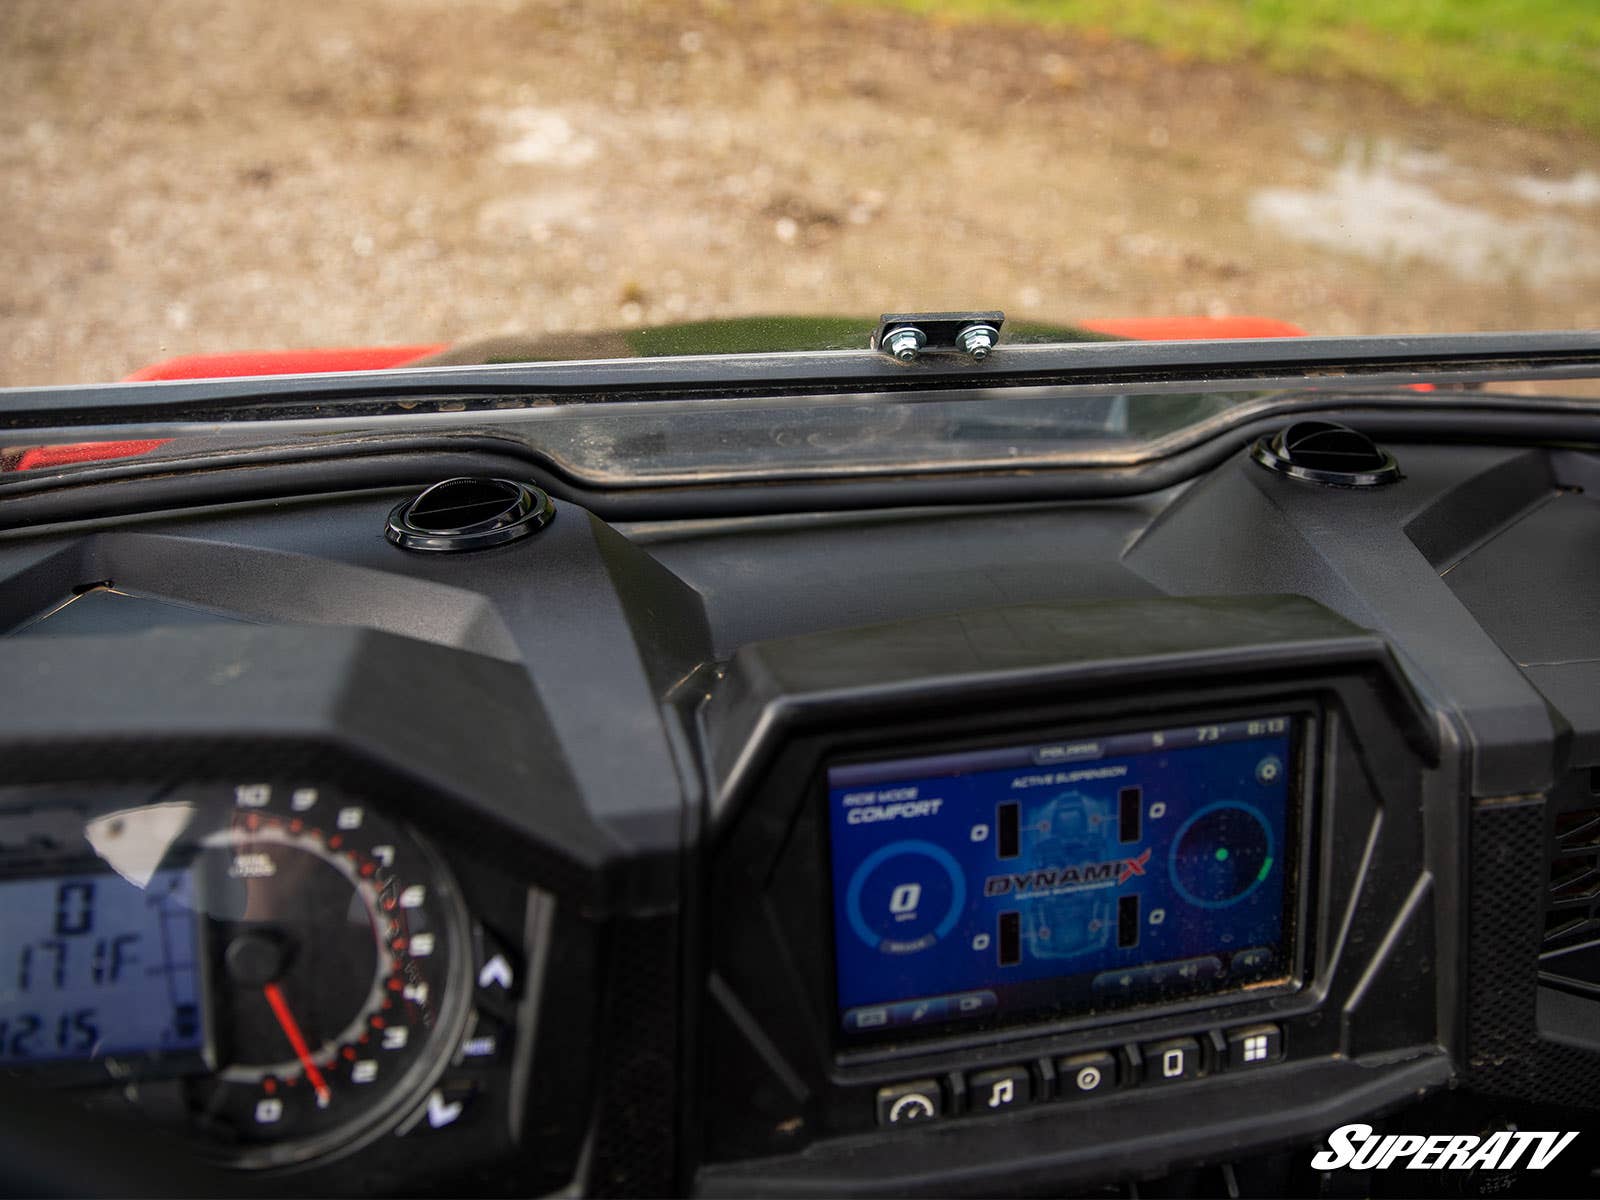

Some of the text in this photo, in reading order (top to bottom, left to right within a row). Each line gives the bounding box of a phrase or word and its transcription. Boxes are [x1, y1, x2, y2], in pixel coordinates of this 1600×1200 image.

[237, 784, 271, 807] 10
[337, 806, 363, 830] 8
[847, 798, 943, 825] COMFORT
[984, 847, 1152, 897] DYNAMIX
[57, 882, 94, 935] 0
[890, 884, 921, 914] 0
[255, 1099, 282, 1123] 0
